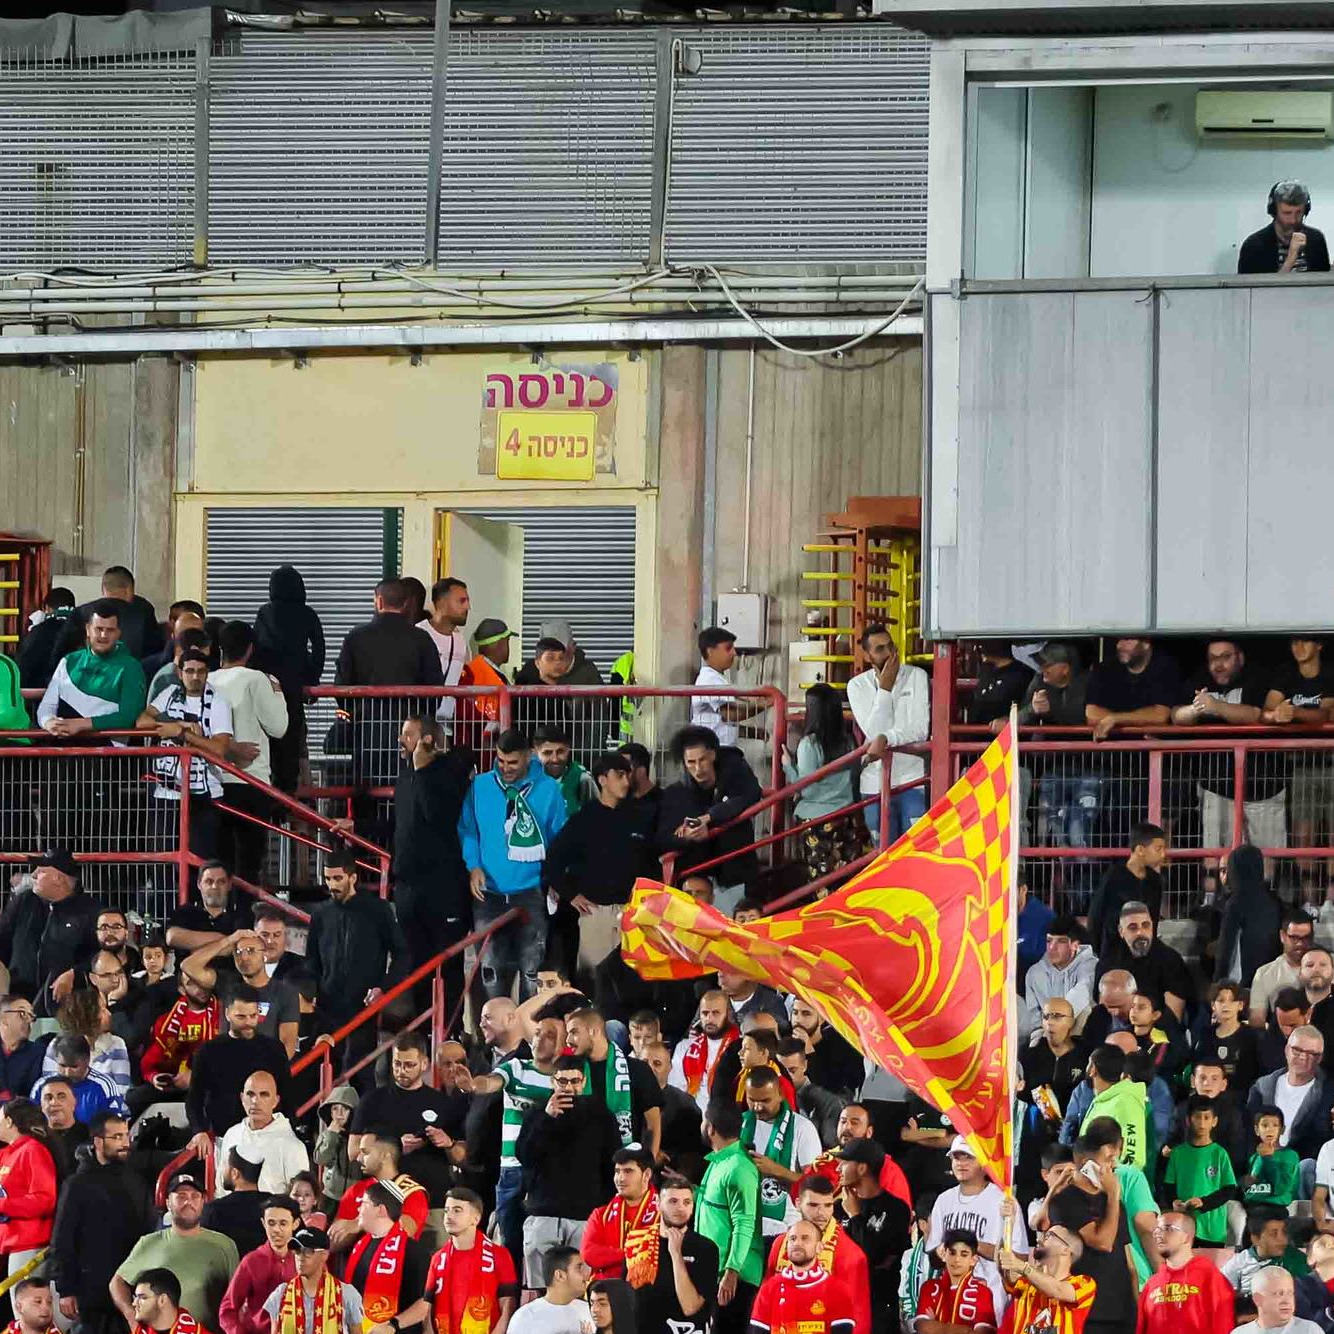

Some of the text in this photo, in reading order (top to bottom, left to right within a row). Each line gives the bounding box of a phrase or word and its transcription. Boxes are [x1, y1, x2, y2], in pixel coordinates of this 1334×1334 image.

[487, 374, 613, 408] כניסה
[505, 427, 589, 458] כניסה 4
